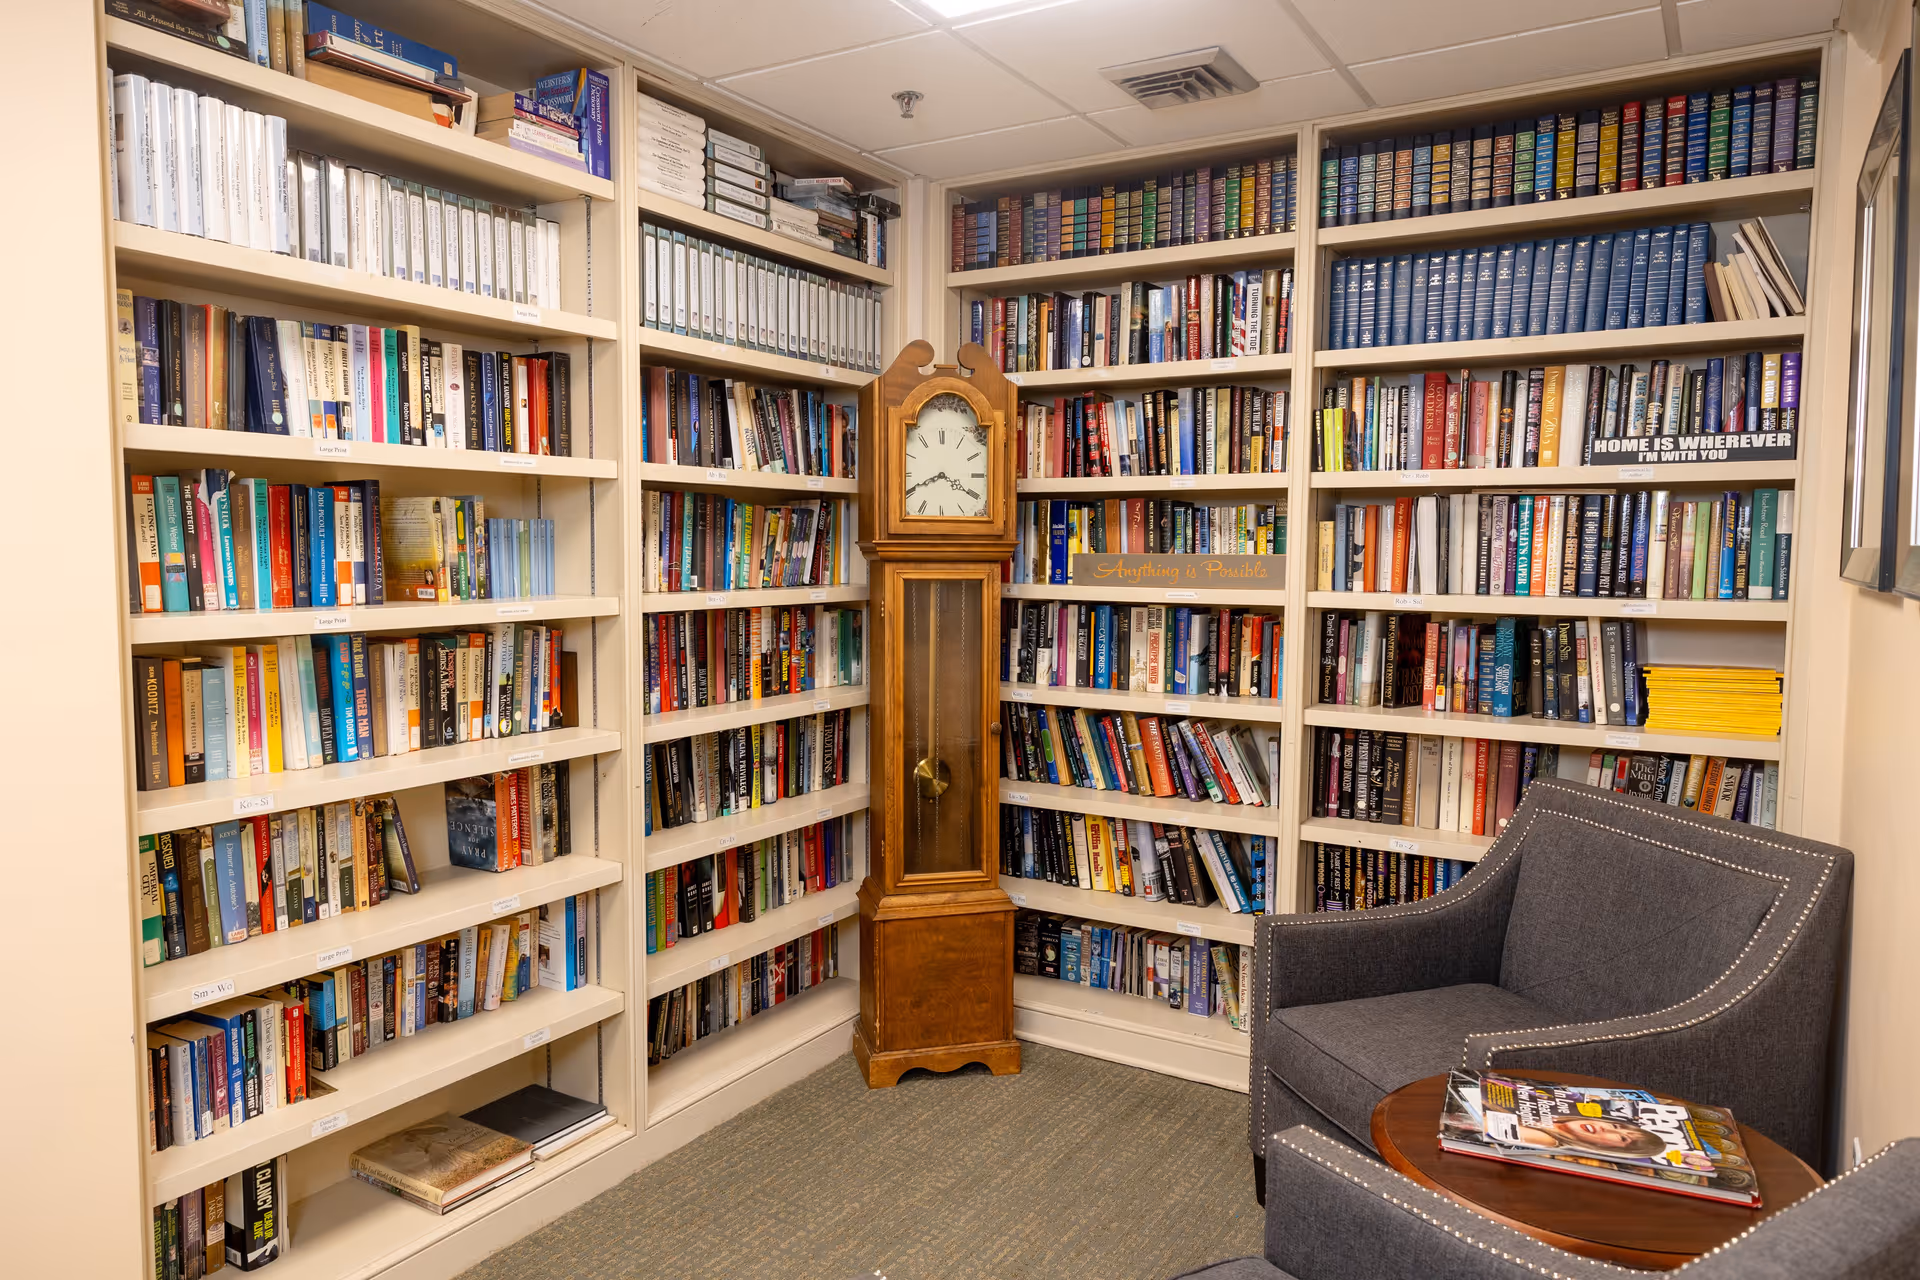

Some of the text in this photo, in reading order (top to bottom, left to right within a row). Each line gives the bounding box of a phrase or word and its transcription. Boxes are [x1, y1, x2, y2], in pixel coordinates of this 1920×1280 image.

[149, 13, 175, 28] Around
[537, 74, 572, 89] WEBSTER'S
[1250, 287, 1259, 318] TURNING
[1249, 335, 1257, 351] TIDE
[422, 356, 430, 390] FALLING
[1426, 383, 1435, 430] SOLDIERS
[1435, 387, 1444, 415] GONE
[320, 446, 334, 454] Large
[1594, 432, 1792, 453] HOME IS WHEREVER
[1638, 449, 1728, 462] I'M WITH YOU
[146, 498, 155, 531] FLYING
[167, 496, 178, 551] Jennifer Weiner
[186, 501, 194, 534] PORTENT
[1092, 558, 1268, 585] Anything is Possible
[1518, 557, 1528, 584] CAPER
[1736, 550, 1746, 588] FINAL STORM
[1327, 614, 1335, 636] Daniel
[1326, 638, 1334, 653] Silva
[353, 637, 369, 738] Max Brand TIGER MAN
[439, 647, 449, 711] James Michener
[147, 679, 158, 715] KOONTZ
[345, 707, 353, 718] TIM
[346, 720, 355, 745] DORSEY
[1148, 720, 1158, 736] THE
[1477, 741, 1486, 779] FRAGILE
[1632, 761, 1654, 772] The
[1630, 771, 1654, 782] Man
[509, 786, 518, 805] JAMES
[160, 834, 174, 869] RESCUED
[142, 874, 150, 896] CITY
[149, 862, 158, 905] IMPERIAL
[226, 843, 239, 911] Dinner at Antoine's
[194, 983, 232, 1000] Sm Wo
[1516, 1085, 1536, 1101] New
[1553, 1089, 1574, 1114] In Love
[256, 1168, 273, 1240] CLANCY DEAD OR
[254, 1220, 262, 1240] ALIVE
